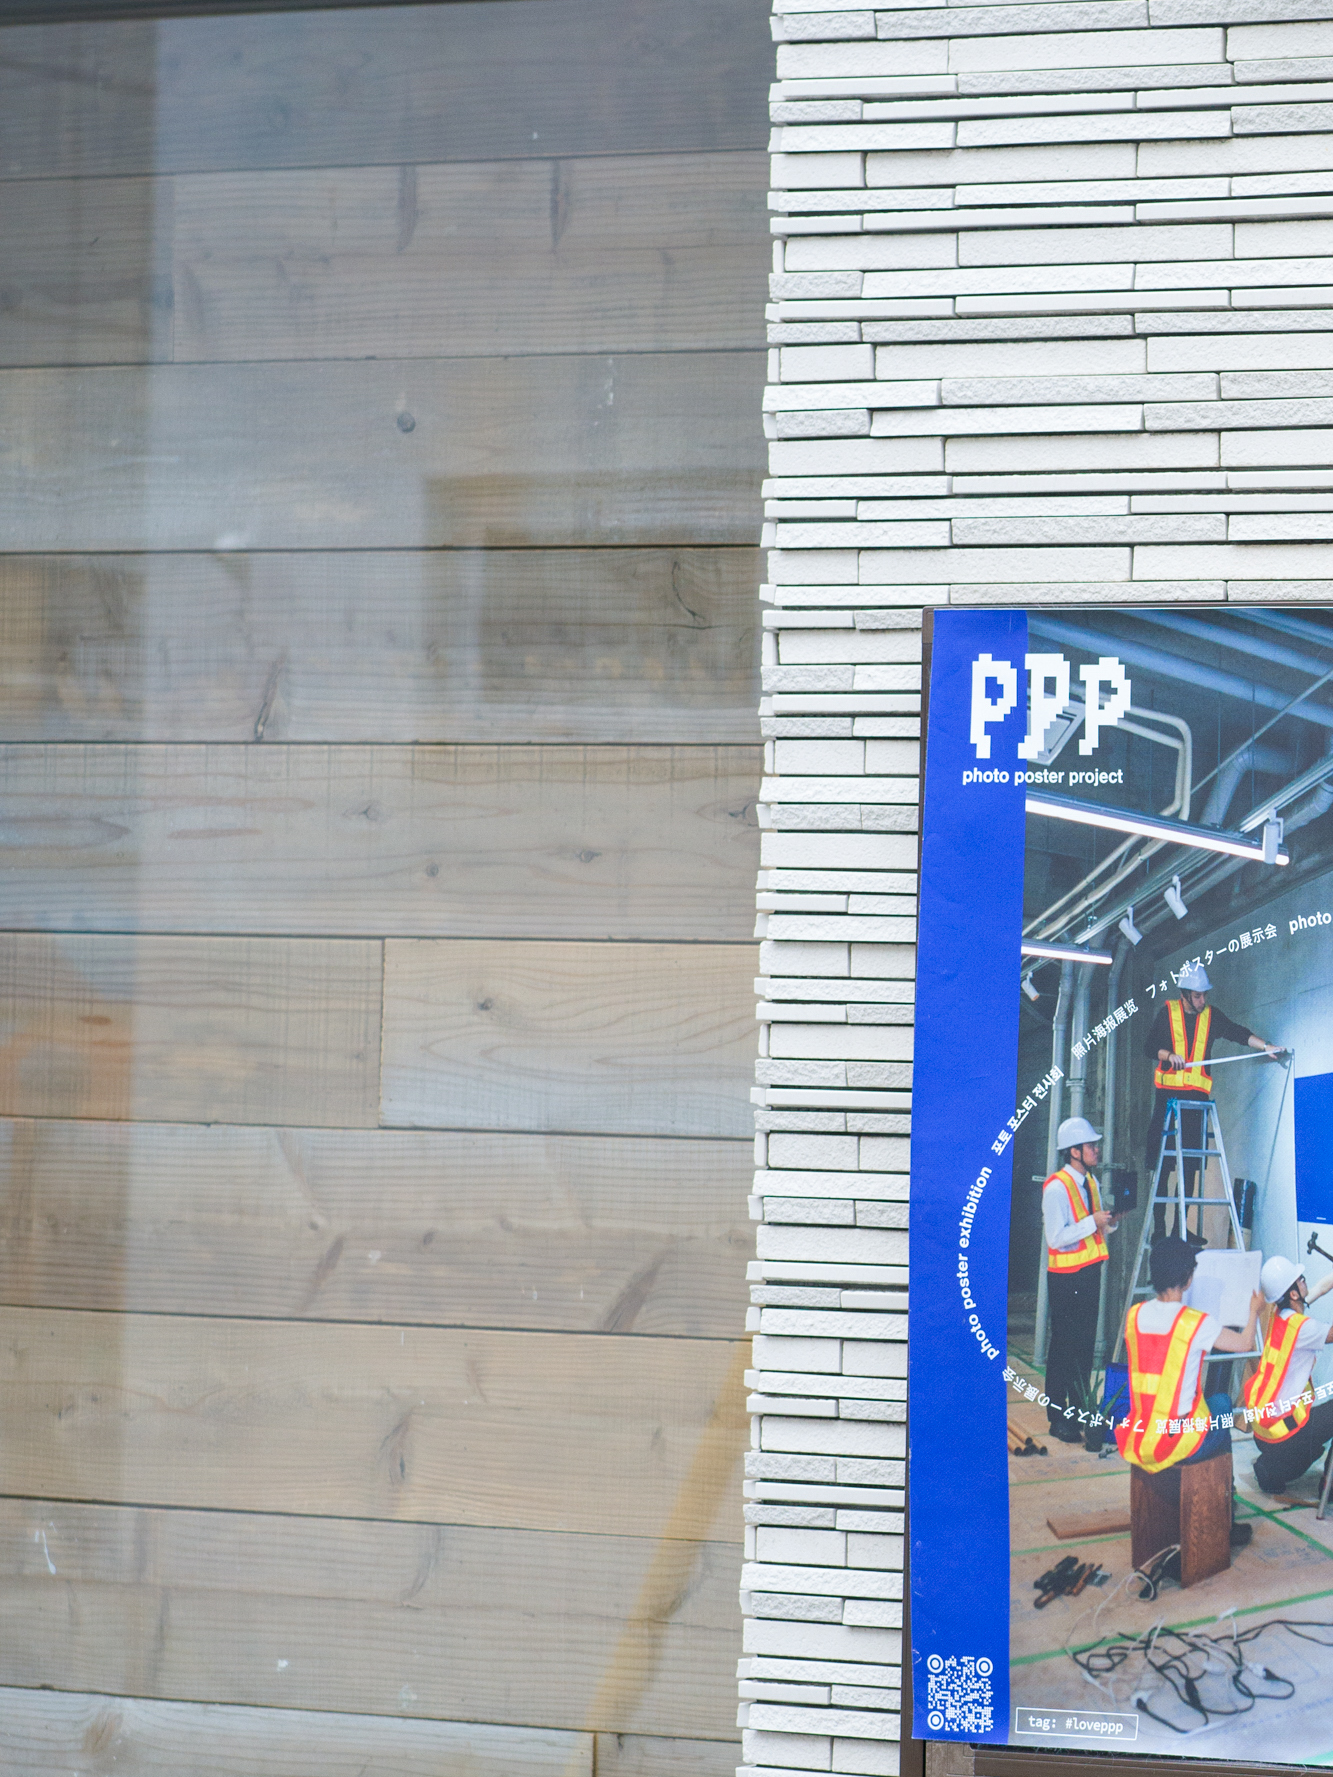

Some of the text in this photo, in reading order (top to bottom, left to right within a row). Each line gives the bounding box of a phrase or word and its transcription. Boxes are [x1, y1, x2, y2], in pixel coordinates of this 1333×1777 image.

[962, 767, 1124, 787] photo poster project
[1288, 910, 1332, 935] photo
[1145, 923, 1278, 999] フォトポスターの展示会
[1070, 998, 1139, 1060] 照片海报展览
[991, 1065, 1065, 1156] 포토 포스터 전시회
[956, 1166, 1000, 1360] photo poster exhibition
[1002, 1365, 1145, 1433] フォトポスターの展示会
[1278, 1390, 1314, 1414] 포스터
[1028, 1715, 1124, 1735] tag: #loveppp
